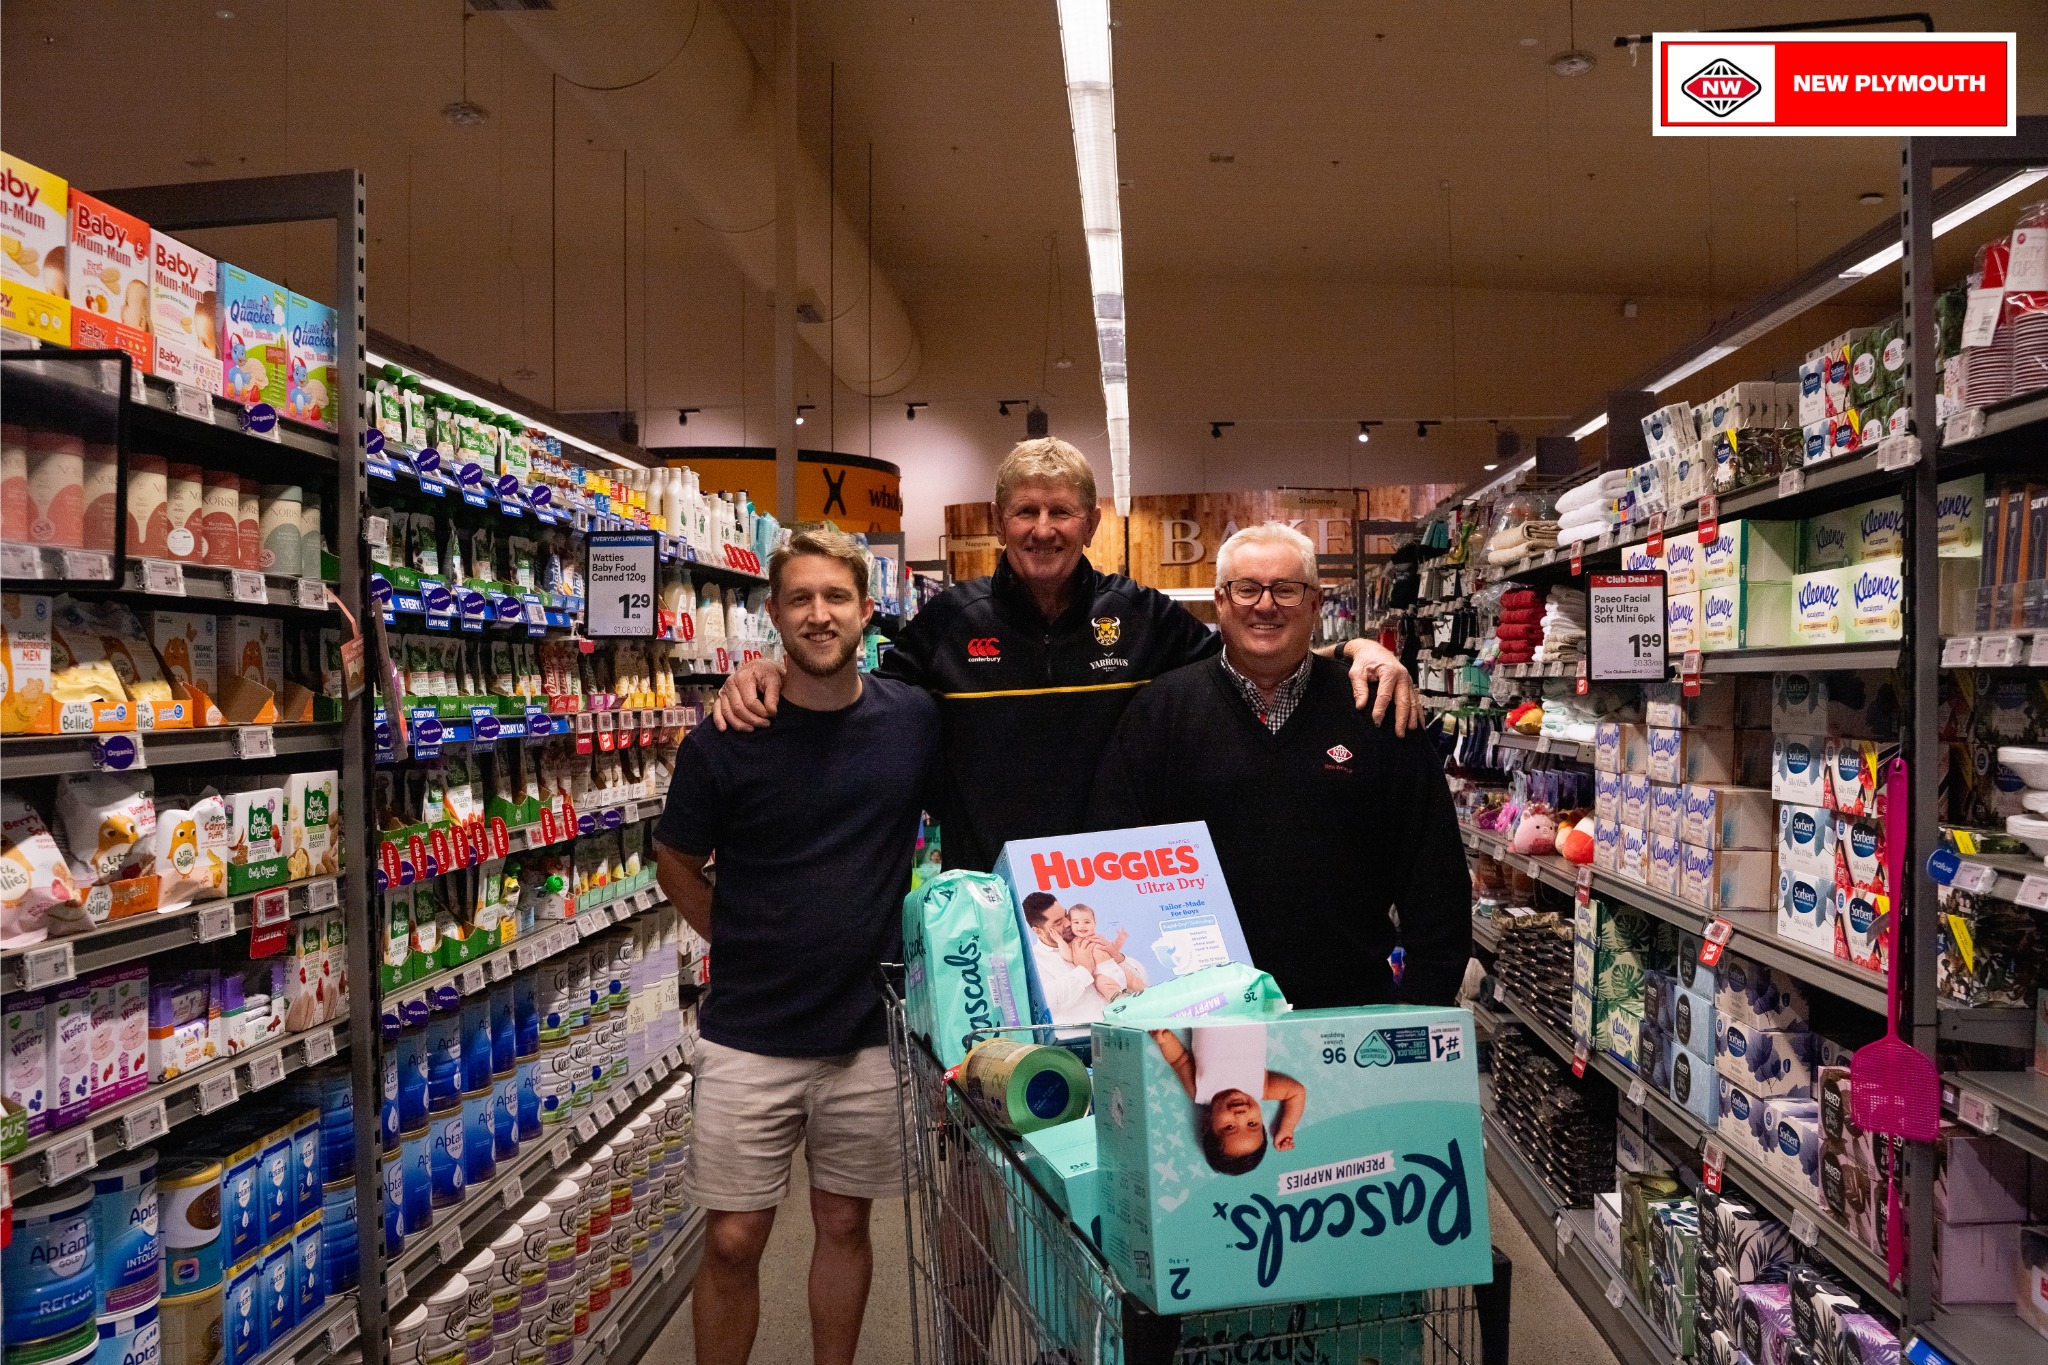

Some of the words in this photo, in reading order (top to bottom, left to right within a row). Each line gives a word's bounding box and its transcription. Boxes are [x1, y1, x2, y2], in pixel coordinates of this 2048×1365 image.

[77, 203, 129, 248] Baby
[76, 232, 131, 268] Mum-Mum
[156, 243, 199, 284] Baby
[156, 269, 204, 304] Mum-Mum
[230, 299, 275, 325] Quacker
[79, 320, 108, 341] Baby
[292, 325, 336, 349] Quacker
[159, 347, 182, 367] Baby
[1804, 375, 1819, 387] Sorbent
[251, 413, 275, 422] Organic
[420, 453, 439, 467] Organic
[463, 467, 481, 480] Organic
[422, 481, 434, 490] LOW
[433, 484, 444, 493] PRICE
[501, 478, 517, 491] Organic
[1298, 496, 1338, 507] Stationery
[1861, 507, 1902, 541] Kleenex
[592, 535, 621, 543] EVERYDAY
[636, 534, 653, 542] PRICE
[592, 553, 625, 562] Watties
[592, 563, 613, 574] Baby
[615, 562, 636, 572] Food
[591, 573, 625, 582] Canned
[625, 572, 646, 583] 120g
[1606, 575, 1627, 584] Club
[1628, 575, 1648, 584] Deal
[1853, 571, 1900, 609] Kleenex
[430, 594, 450, 604] Organic
[466, 599, 485, 609] Organic
[1594, 594, 1622, 603] Paseo
[1623, 594, 1651, 603] Facial
[1798, 581, 1839, 614] Kleenex
[502, 603, 520, 613] Organic
[1594, 605, 1615, 615] 3ply
[1616, 605, 1639, 613] Ultra
[1705, 595, 1733, 625] Kleenex
[428, 619, 438, 627] LOW
[438, 619, 449, 627] PRICE
[1594, 614, 1614, 623] Soft
[1616, 613, 1636, 623] Mini
[1637, 613, 1656, 624] 6pk
[17, 631, 47, 641] ORGANIC
[22, 650, 41, 662] MEN
[1090, 658, 1129, 669] YARROWS
[67, 703, 88, 715] Little
[413, 710, 435, 718] EVERYDAY
[62, 714, 93, 731] Bellies
[533, 721, 550, 729] Organic
[421, 727, 442, 735] Organic
[107, 748, 133, 758] Organic
[1788, 751, 1809, 762] Sorbent
[1839, 755, 1861, 767] Sorbent
[309, 796, 323, 808] Only
[253, 813, 266, 825] Only
[306, 806, 327, 822] Organic
[250, 824, 272, 837] Organic
[1793, 819, 1815, 832] Sorbent
[1853, 830, 1876, 845] Sorbent
[457, 846, 465, 860] Deal
[477, 841, 485, 855] Deal
[387, 849, 395, 864] Club
[248, 867, 260, 878] Only
[260, 863, 279, 878] Organic
[388, 864, 396, 883] Deal
[1030, 845, 1200, 891] HUGGIES
[1932, 859, 1953, 874] value
[1136, 881, 1175, 895] Ultra
[1177, 877, 1205, 890] Dry
[1794, 889, 1815, 901] Sorbent
[1159, 900, 1206, 912] Tailor-Made
[1171, 909, 1182, 917] For
[1183, 908, 1199, 916] Boys
[1851, 904, 1875, 921] Sorbent
[1703, 952, 1714, 961] Deal
[990, 977, 1000, 1004] PREMIUM
[1244, 991, 1258, 1003] 26
[121, 1001, 146, 1021] Wafers
[91, 1009, 114, 1030] Wafers
[60, 1021, 88, 1043] Wafers
[11, 1034, 43, 1056] Wafers
[1432, 1034, 1459, 1059] #1
[1728, 1031, 1746, 1048] Sorbent
[1322, 1047, 1347, 1065] 96
[1731, 1095, 1749, 1115] Sorbent
[1779, 1126, 1800, 1149] Sorbent
[1333, 1156, 1386, 1181] PREMIUM
[1285, 1168, 1333, 1191] NAPPIES
[1169, 1266, 1192, 1300] 2
